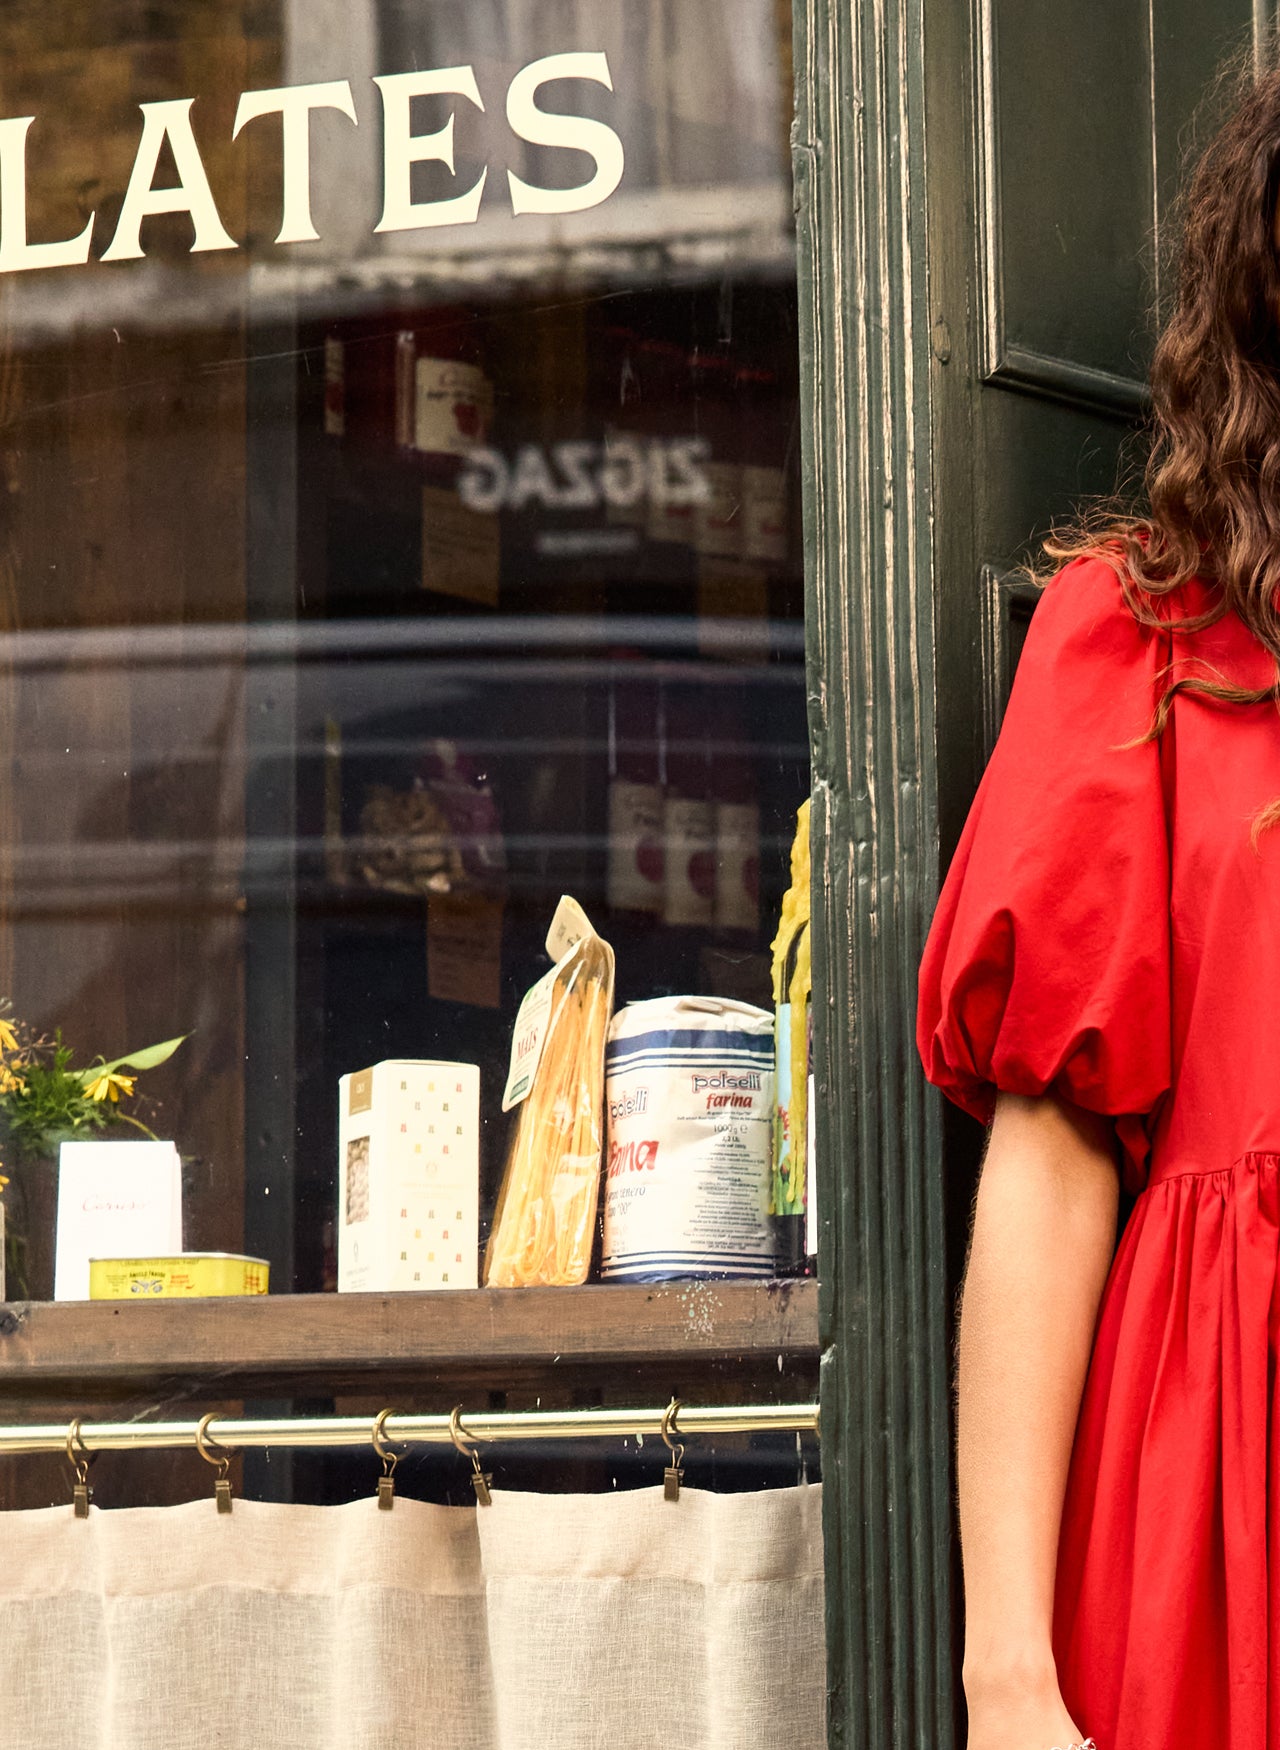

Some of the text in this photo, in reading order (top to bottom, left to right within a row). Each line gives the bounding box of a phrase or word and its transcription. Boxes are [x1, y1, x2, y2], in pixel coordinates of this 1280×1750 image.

[0, 51, 625, 273] LATES
[692, 1070, 761, 1093] polselli
[706, 1092, 753, 1110] farina
